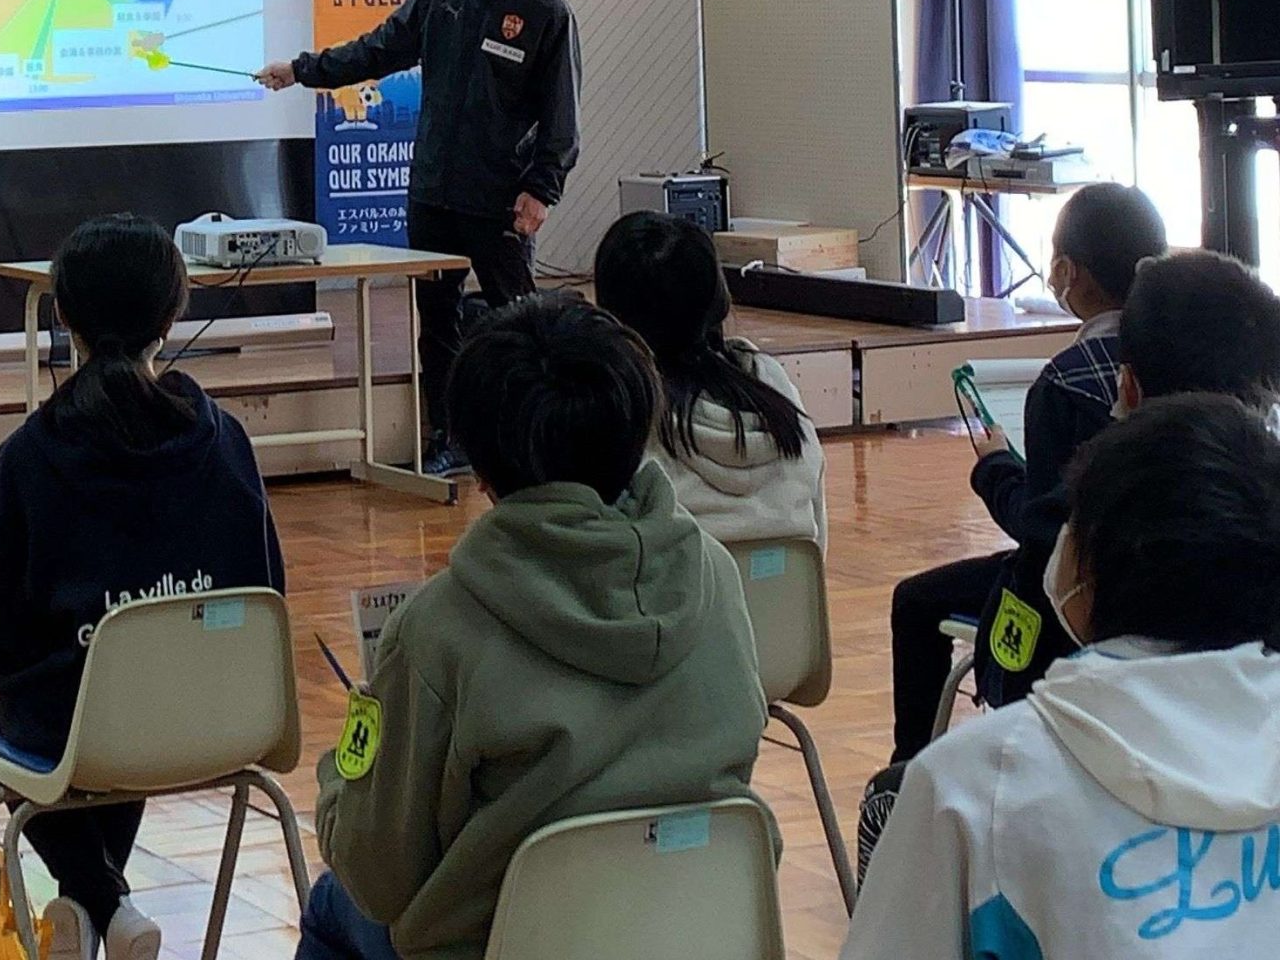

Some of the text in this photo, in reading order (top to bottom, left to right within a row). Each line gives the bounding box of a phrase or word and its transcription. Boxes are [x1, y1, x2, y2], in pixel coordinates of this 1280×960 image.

[328, 143, 362, 164] OUR
[328, 169, 362, 190] OUR
[338, 220, 407, 234] ファミリータ
[139, 572, 186, 598] ville
[191, 569, 213, 592] de
